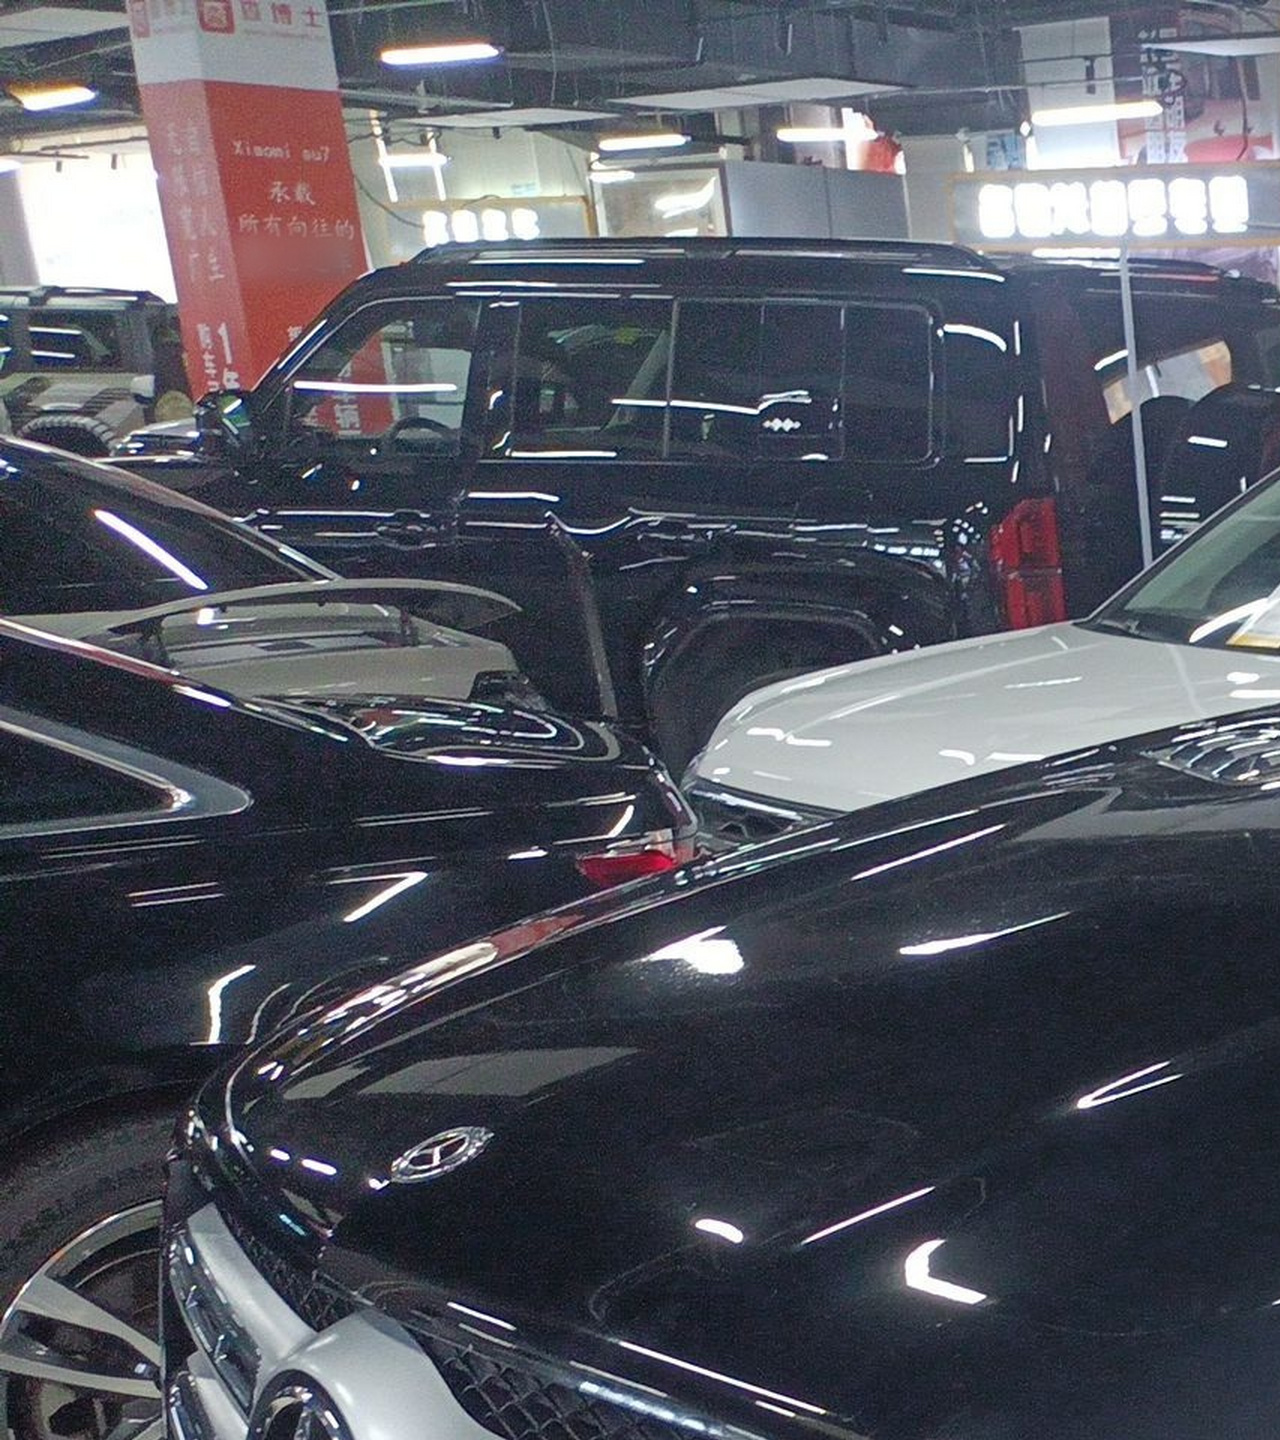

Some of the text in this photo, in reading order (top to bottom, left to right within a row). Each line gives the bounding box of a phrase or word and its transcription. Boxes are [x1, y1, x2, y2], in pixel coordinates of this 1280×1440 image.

[238, 213, 355, 240] 所有向往的
